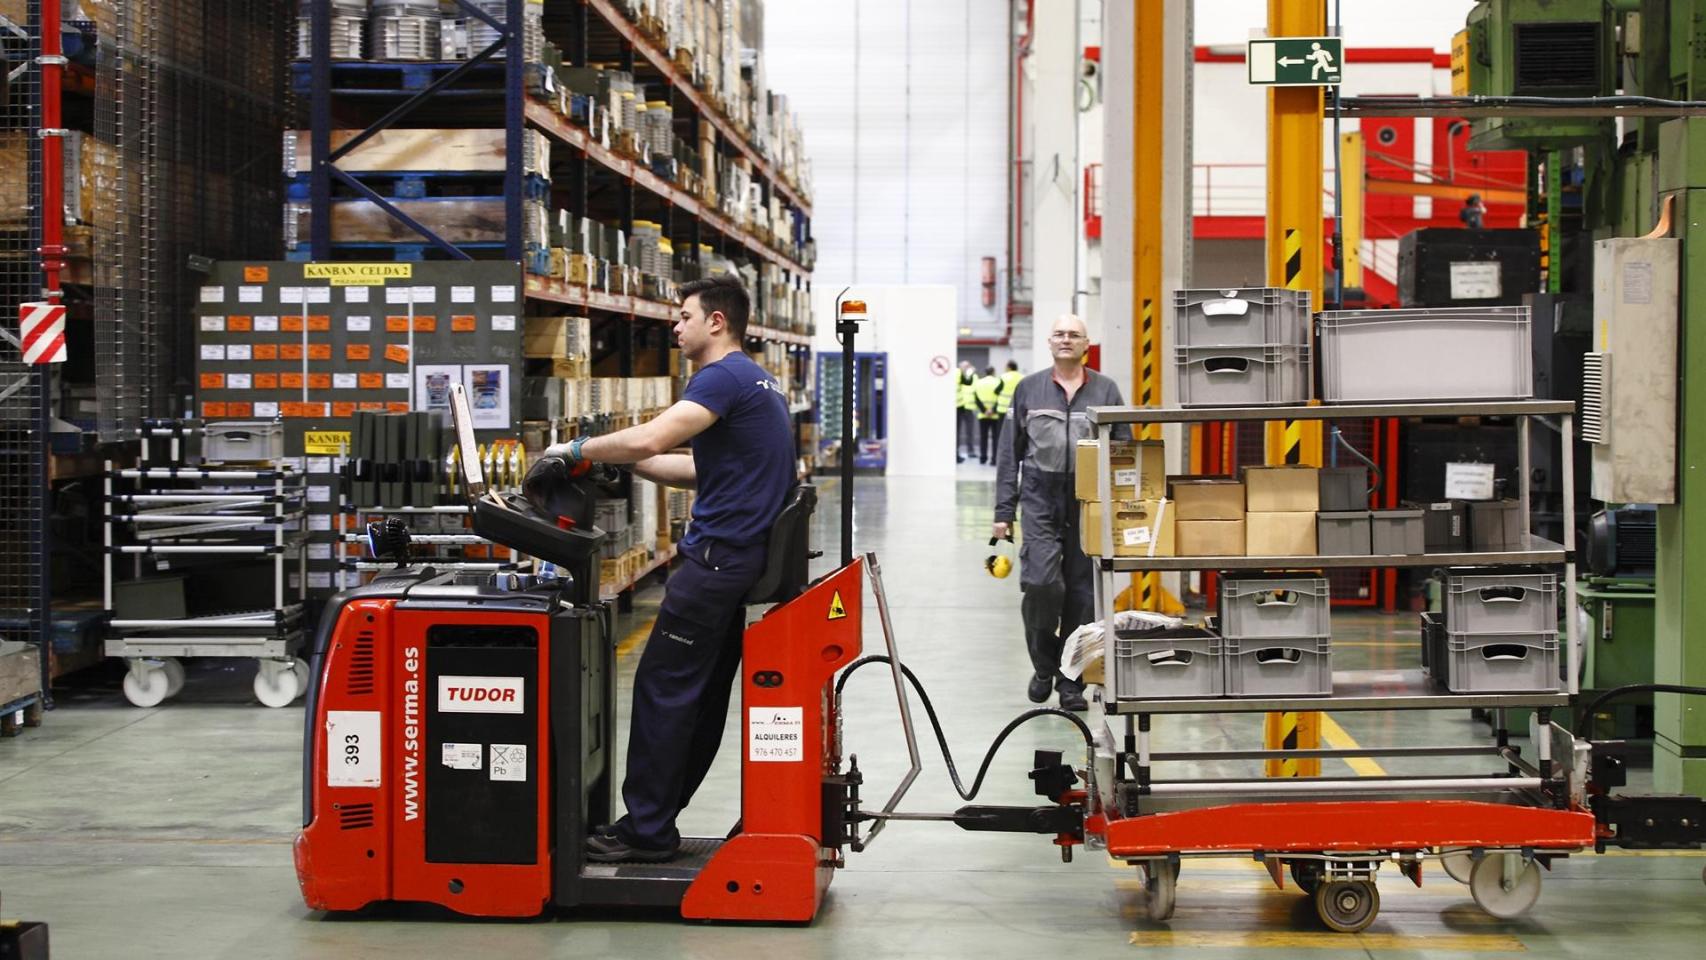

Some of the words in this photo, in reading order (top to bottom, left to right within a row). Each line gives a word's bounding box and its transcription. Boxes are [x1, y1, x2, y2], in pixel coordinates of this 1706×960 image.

[307, 266, 355, 276] KANBAN
[360, 266, 399, 276] CELDA
[403, 266, 409, 276] 2
[307, 434, 349, 444] KANBA
[447, 687, 516, 702] TUDOR
[404, 646, 419, 822] www.serma.es
[754, 733, 798, 741] ALQUILERES
[345, 734, 360, 766] 393
[493, 766, 507, 775] Pb
